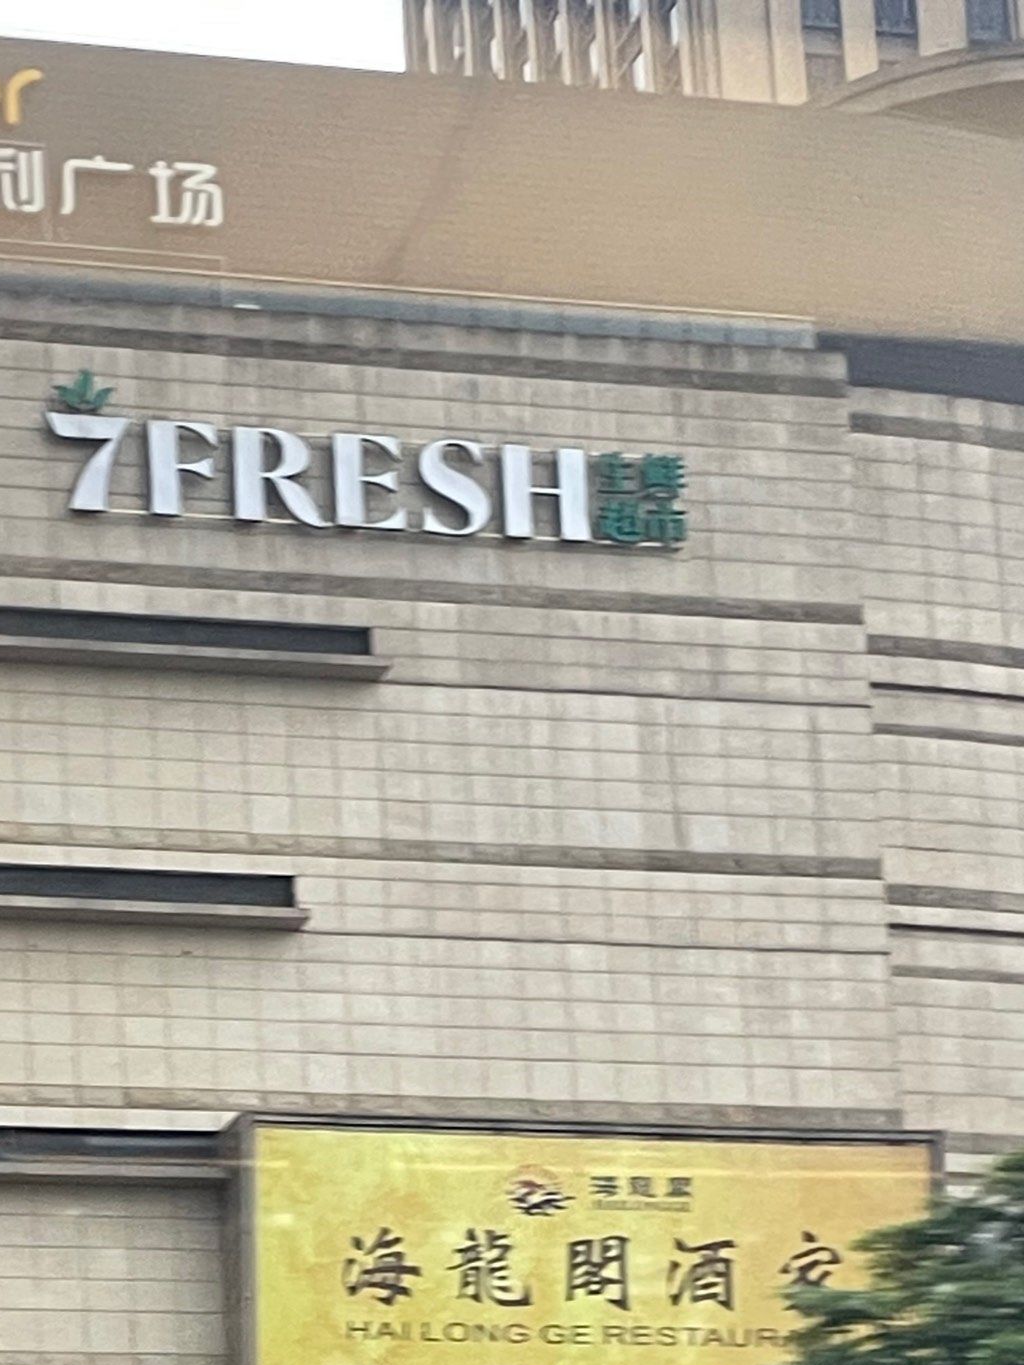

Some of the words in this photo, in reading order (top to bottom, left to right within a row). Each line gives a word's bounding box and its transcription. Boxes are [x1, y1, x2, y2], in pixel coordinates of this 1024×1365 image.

[44, 410, 592, 543] 7FRESH
[346, 1319, 413, 1342] HAI
[420, 1321, 531, 1345] LONG
[538, 1323, 593, 1346] GE
[601, 1325, 793, 1349] RESTAUR
